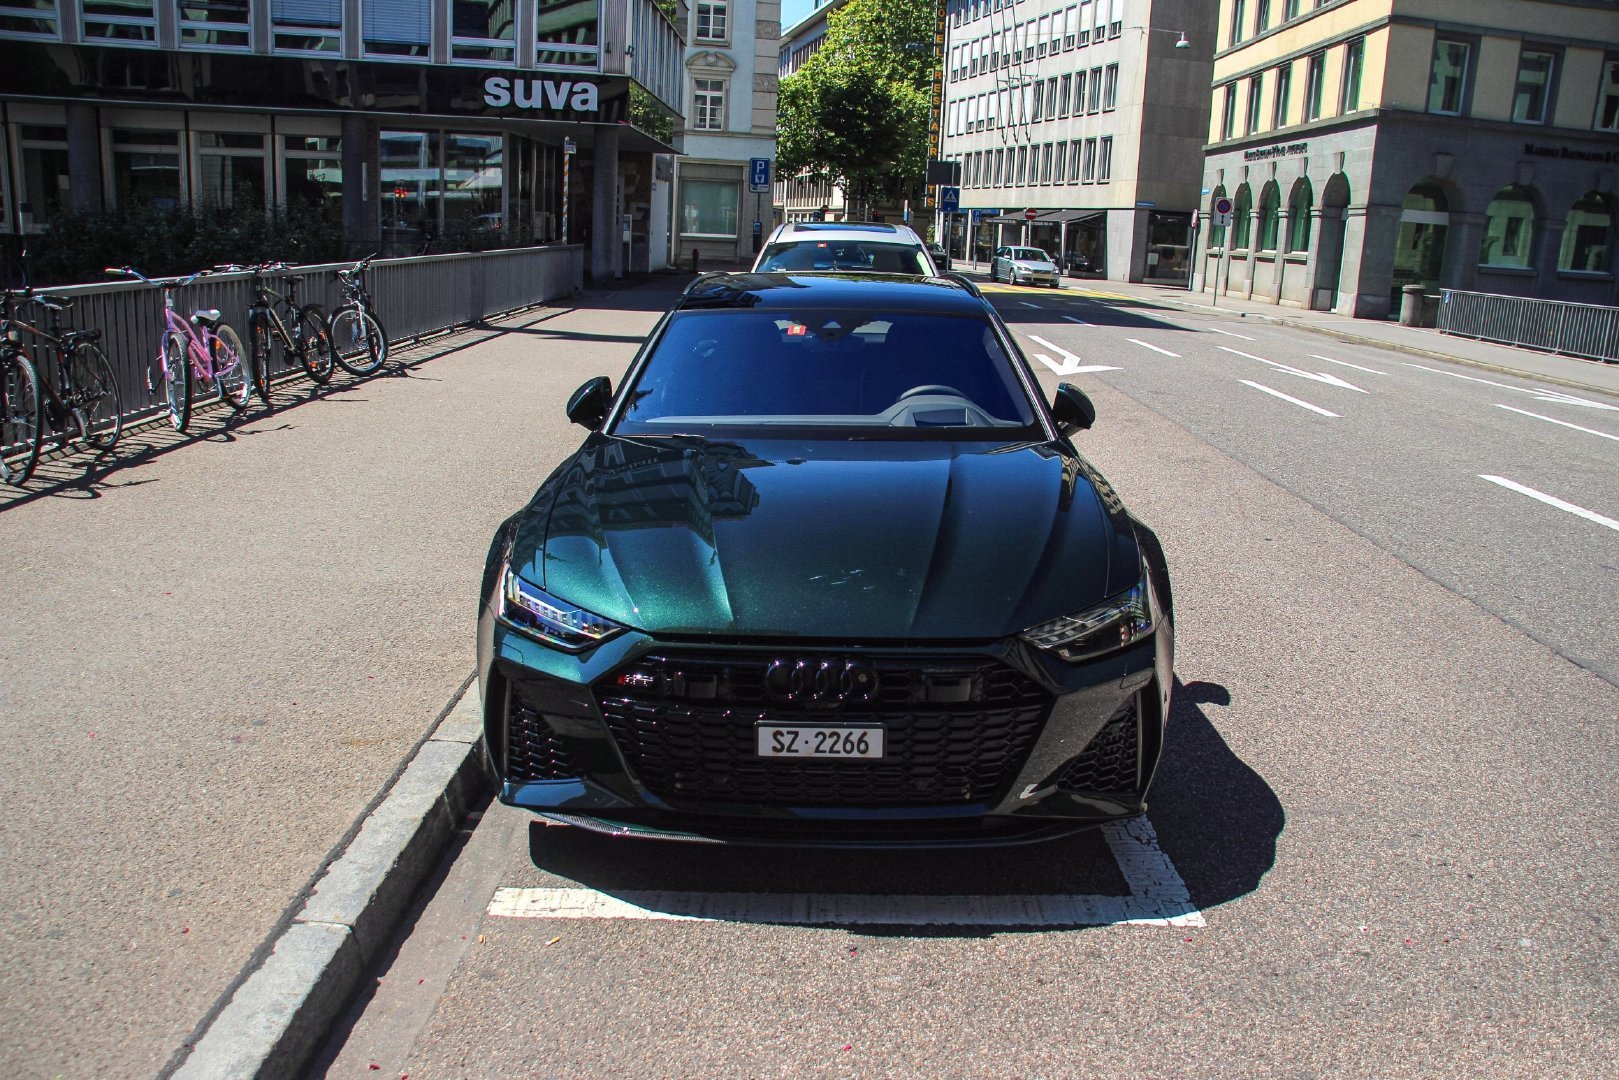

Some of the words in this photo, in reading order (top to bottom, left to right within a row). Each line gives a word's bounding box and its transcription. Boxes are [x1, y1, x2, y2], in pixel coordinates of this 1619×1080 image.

[936, 0, 946, 56] OTEL
[483, 76, 599, 112] suva
[927, 72, 942, 206] RESTAURTS
[756, 161, 765, 174] P
